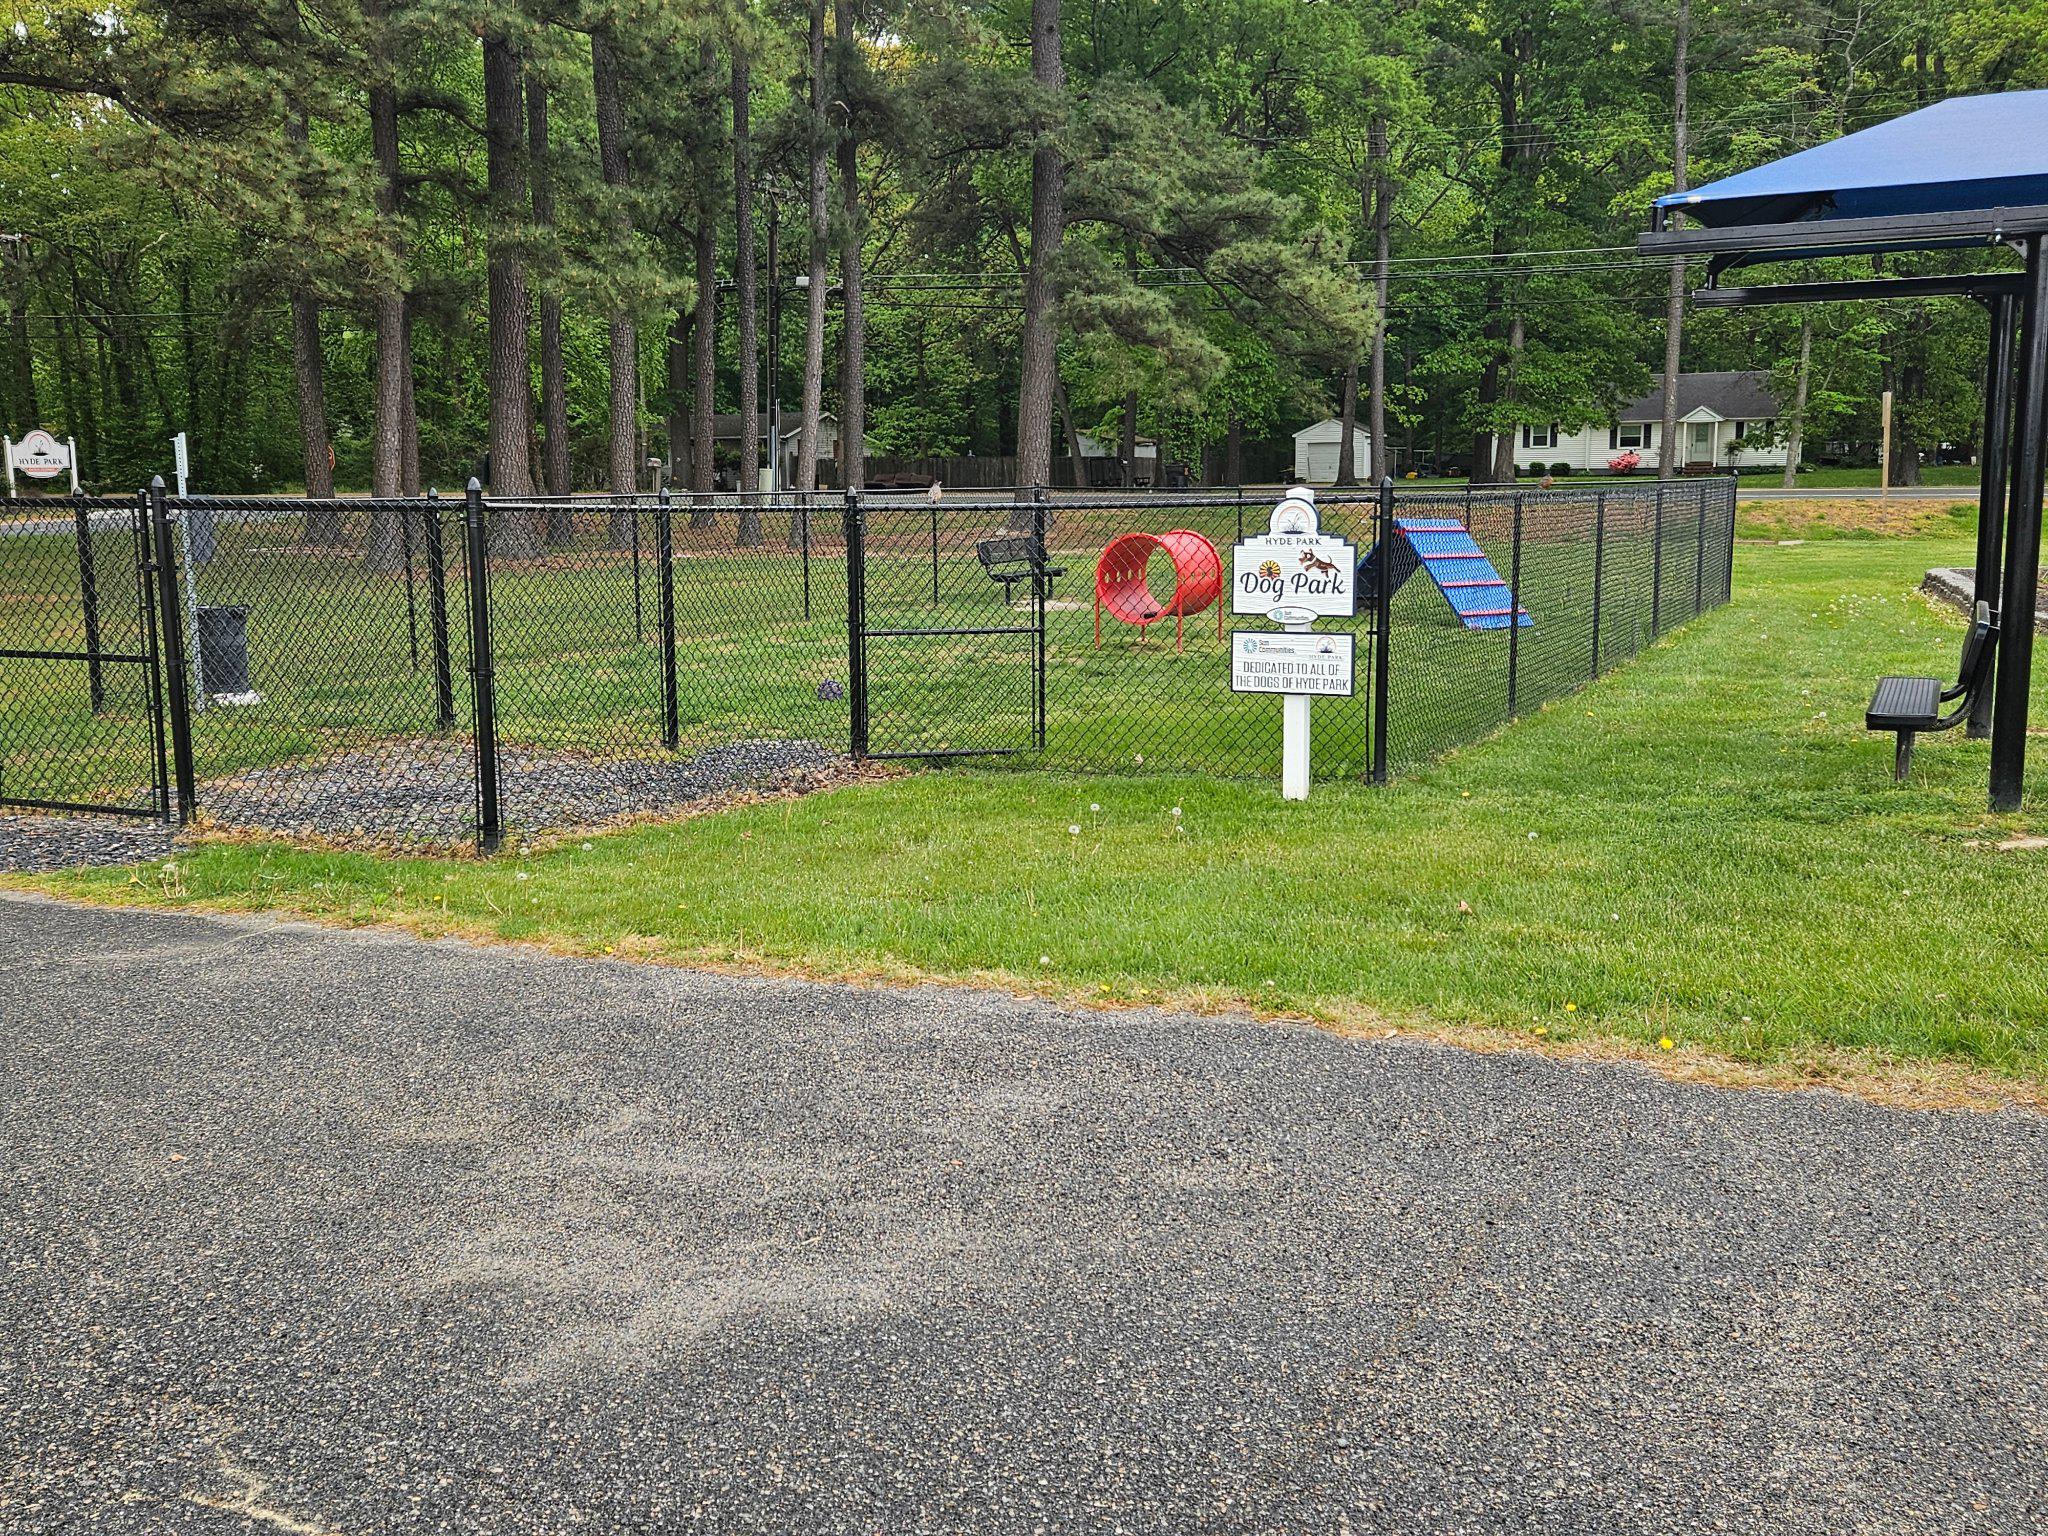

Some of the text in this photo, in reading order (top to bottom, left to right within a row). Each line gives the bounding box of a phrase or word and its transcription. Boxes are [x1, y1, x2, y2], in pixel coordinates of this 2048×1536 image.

[1265, 537, 1322, 546] HYDE PARK
[1240, 572, 1346, 602] Dog Park
[1259, 646, 1295, 654] Communities
[1243, 661, 1340, 676] DEDICATED TO ALL OF
[1236, 675, 1349, 691] THE DOGS OF HYDE PARK
